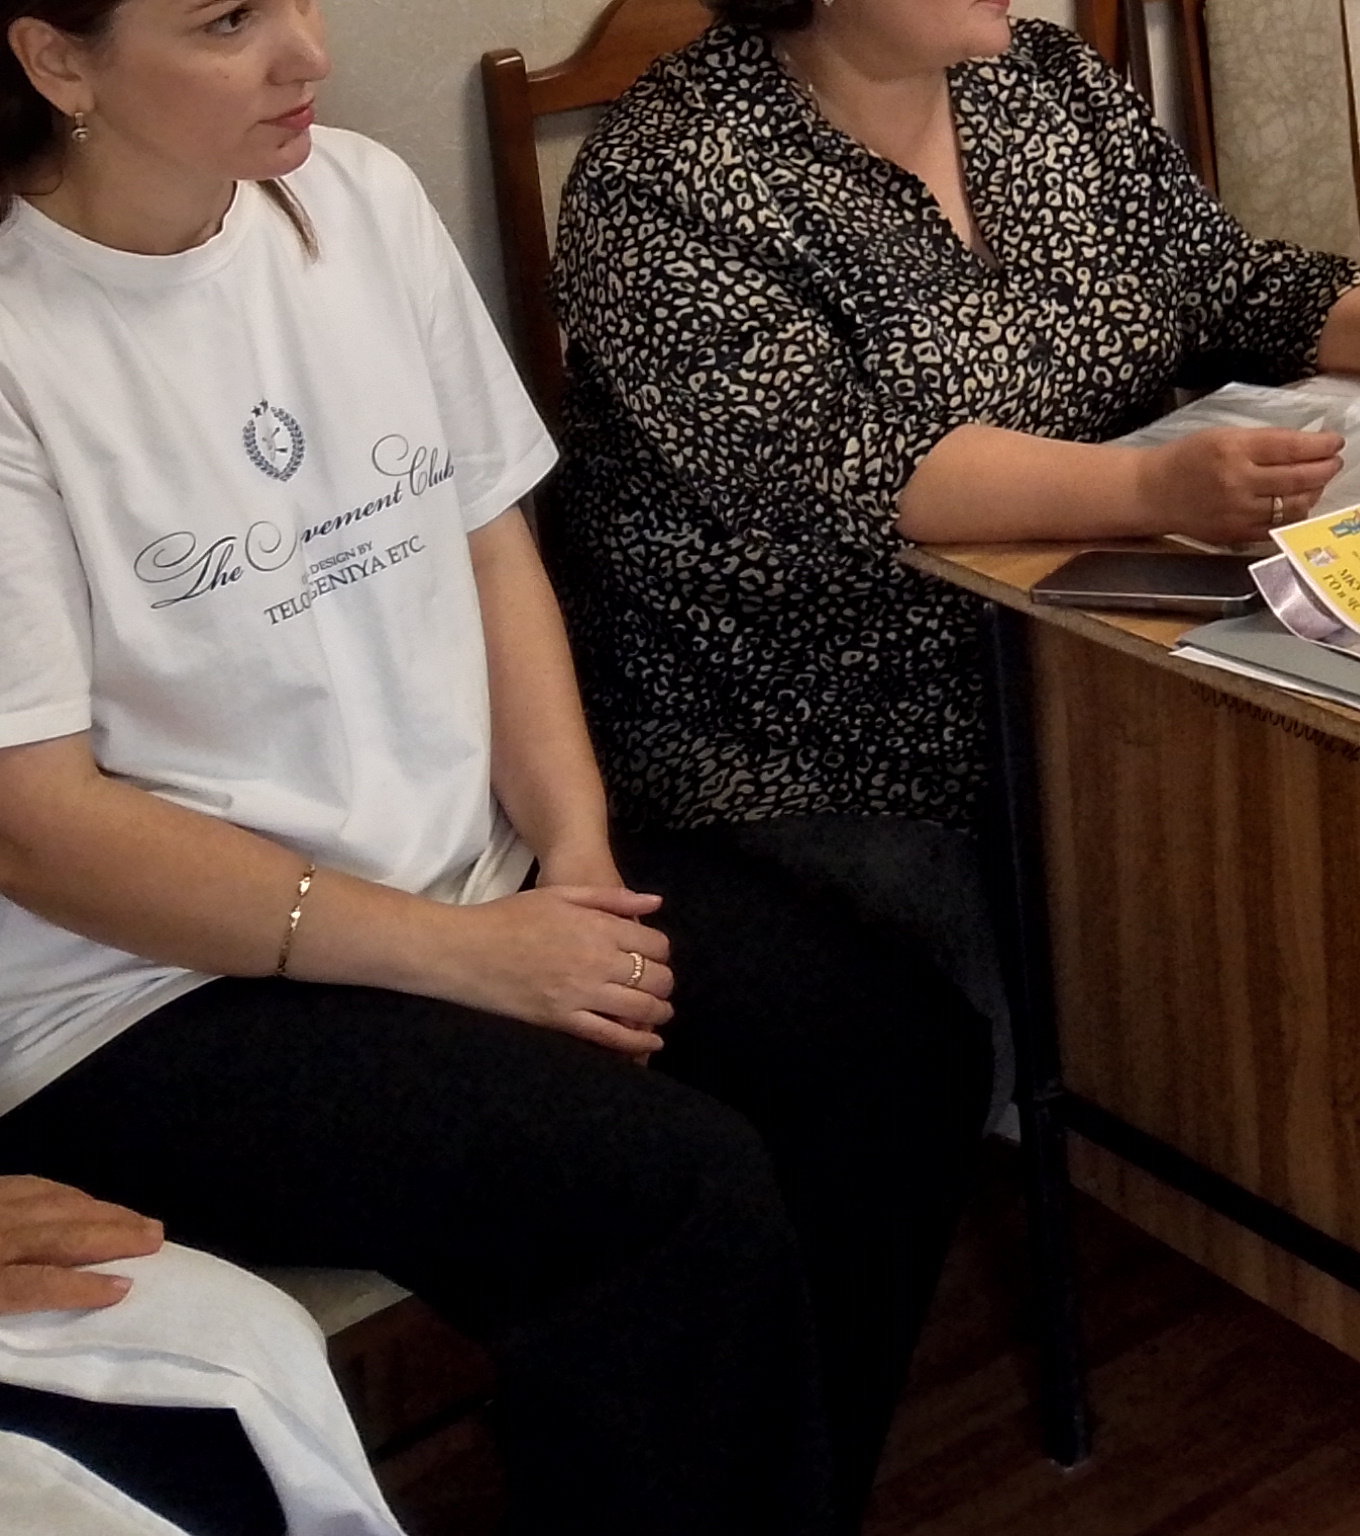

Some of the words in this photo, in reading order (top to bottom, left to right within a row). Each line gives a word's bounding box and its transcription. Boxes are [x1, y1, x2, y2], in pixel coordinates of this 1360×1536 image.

[134, 531, 245, 610] The
[371, 433, 456, 496] Club
[310, 548, 357, 575] DESIGN
[358, 541, 374, 557] BY
[385, 535, 427, 565] ETC
[1323, 574, 1340, 591] ГО
